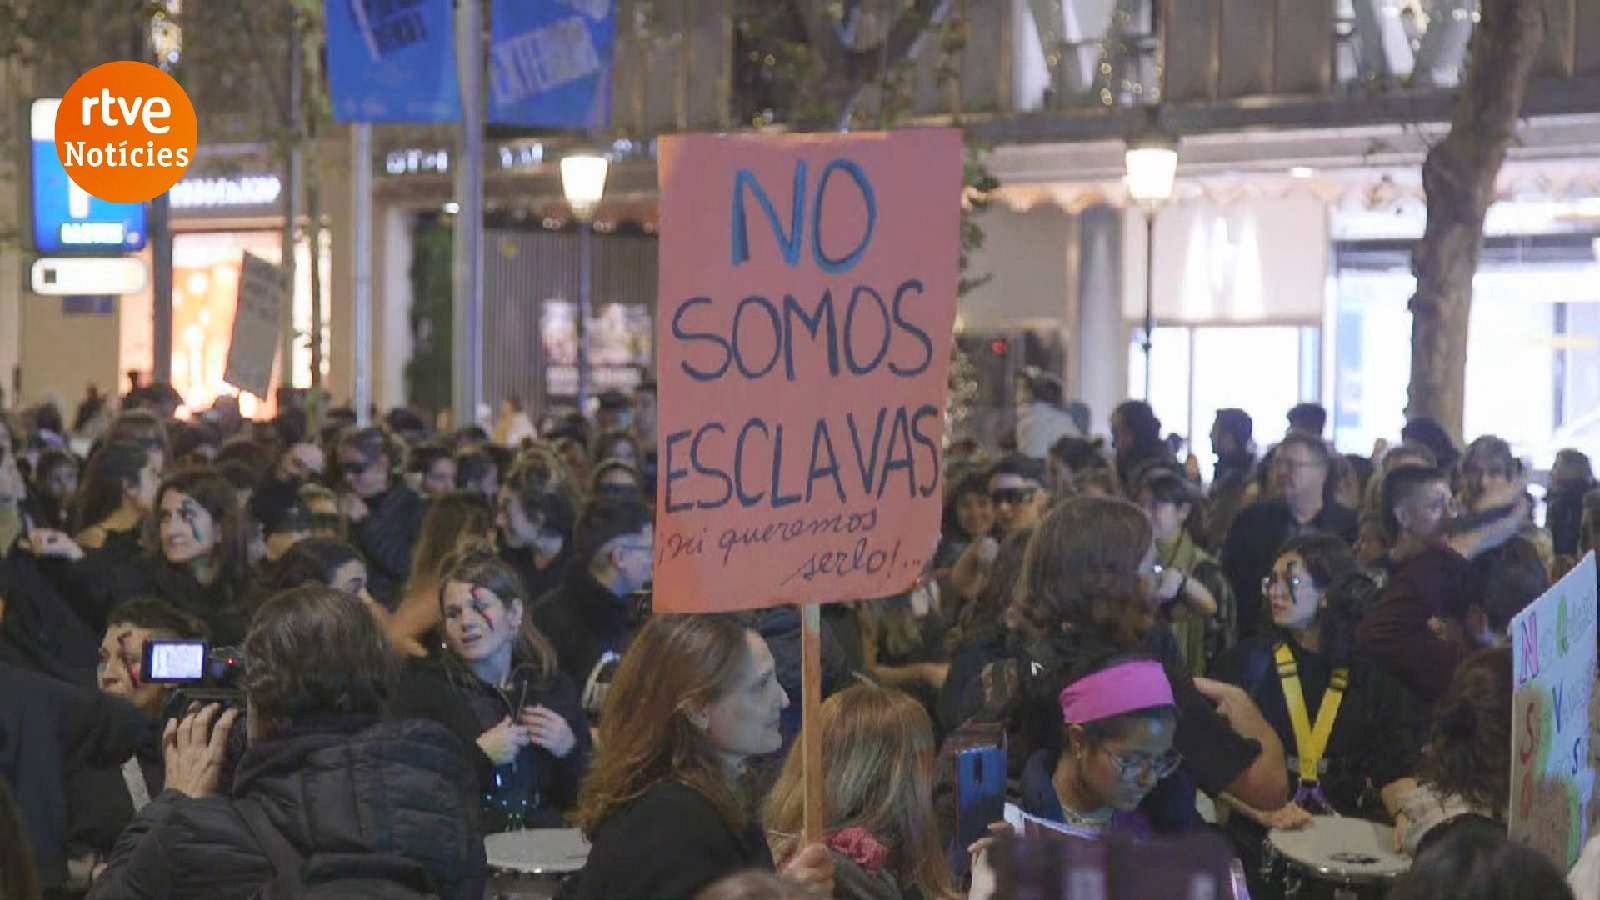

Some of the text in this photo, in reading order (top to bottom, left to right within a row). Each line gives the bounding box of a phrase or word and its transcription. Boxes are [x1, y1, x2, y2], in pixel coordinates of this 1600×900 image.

[730, 158, 878, 274] NO
[671, 278, 933, 383] SOMOS
[664, 404, 938, 514] ESCLAVAS
